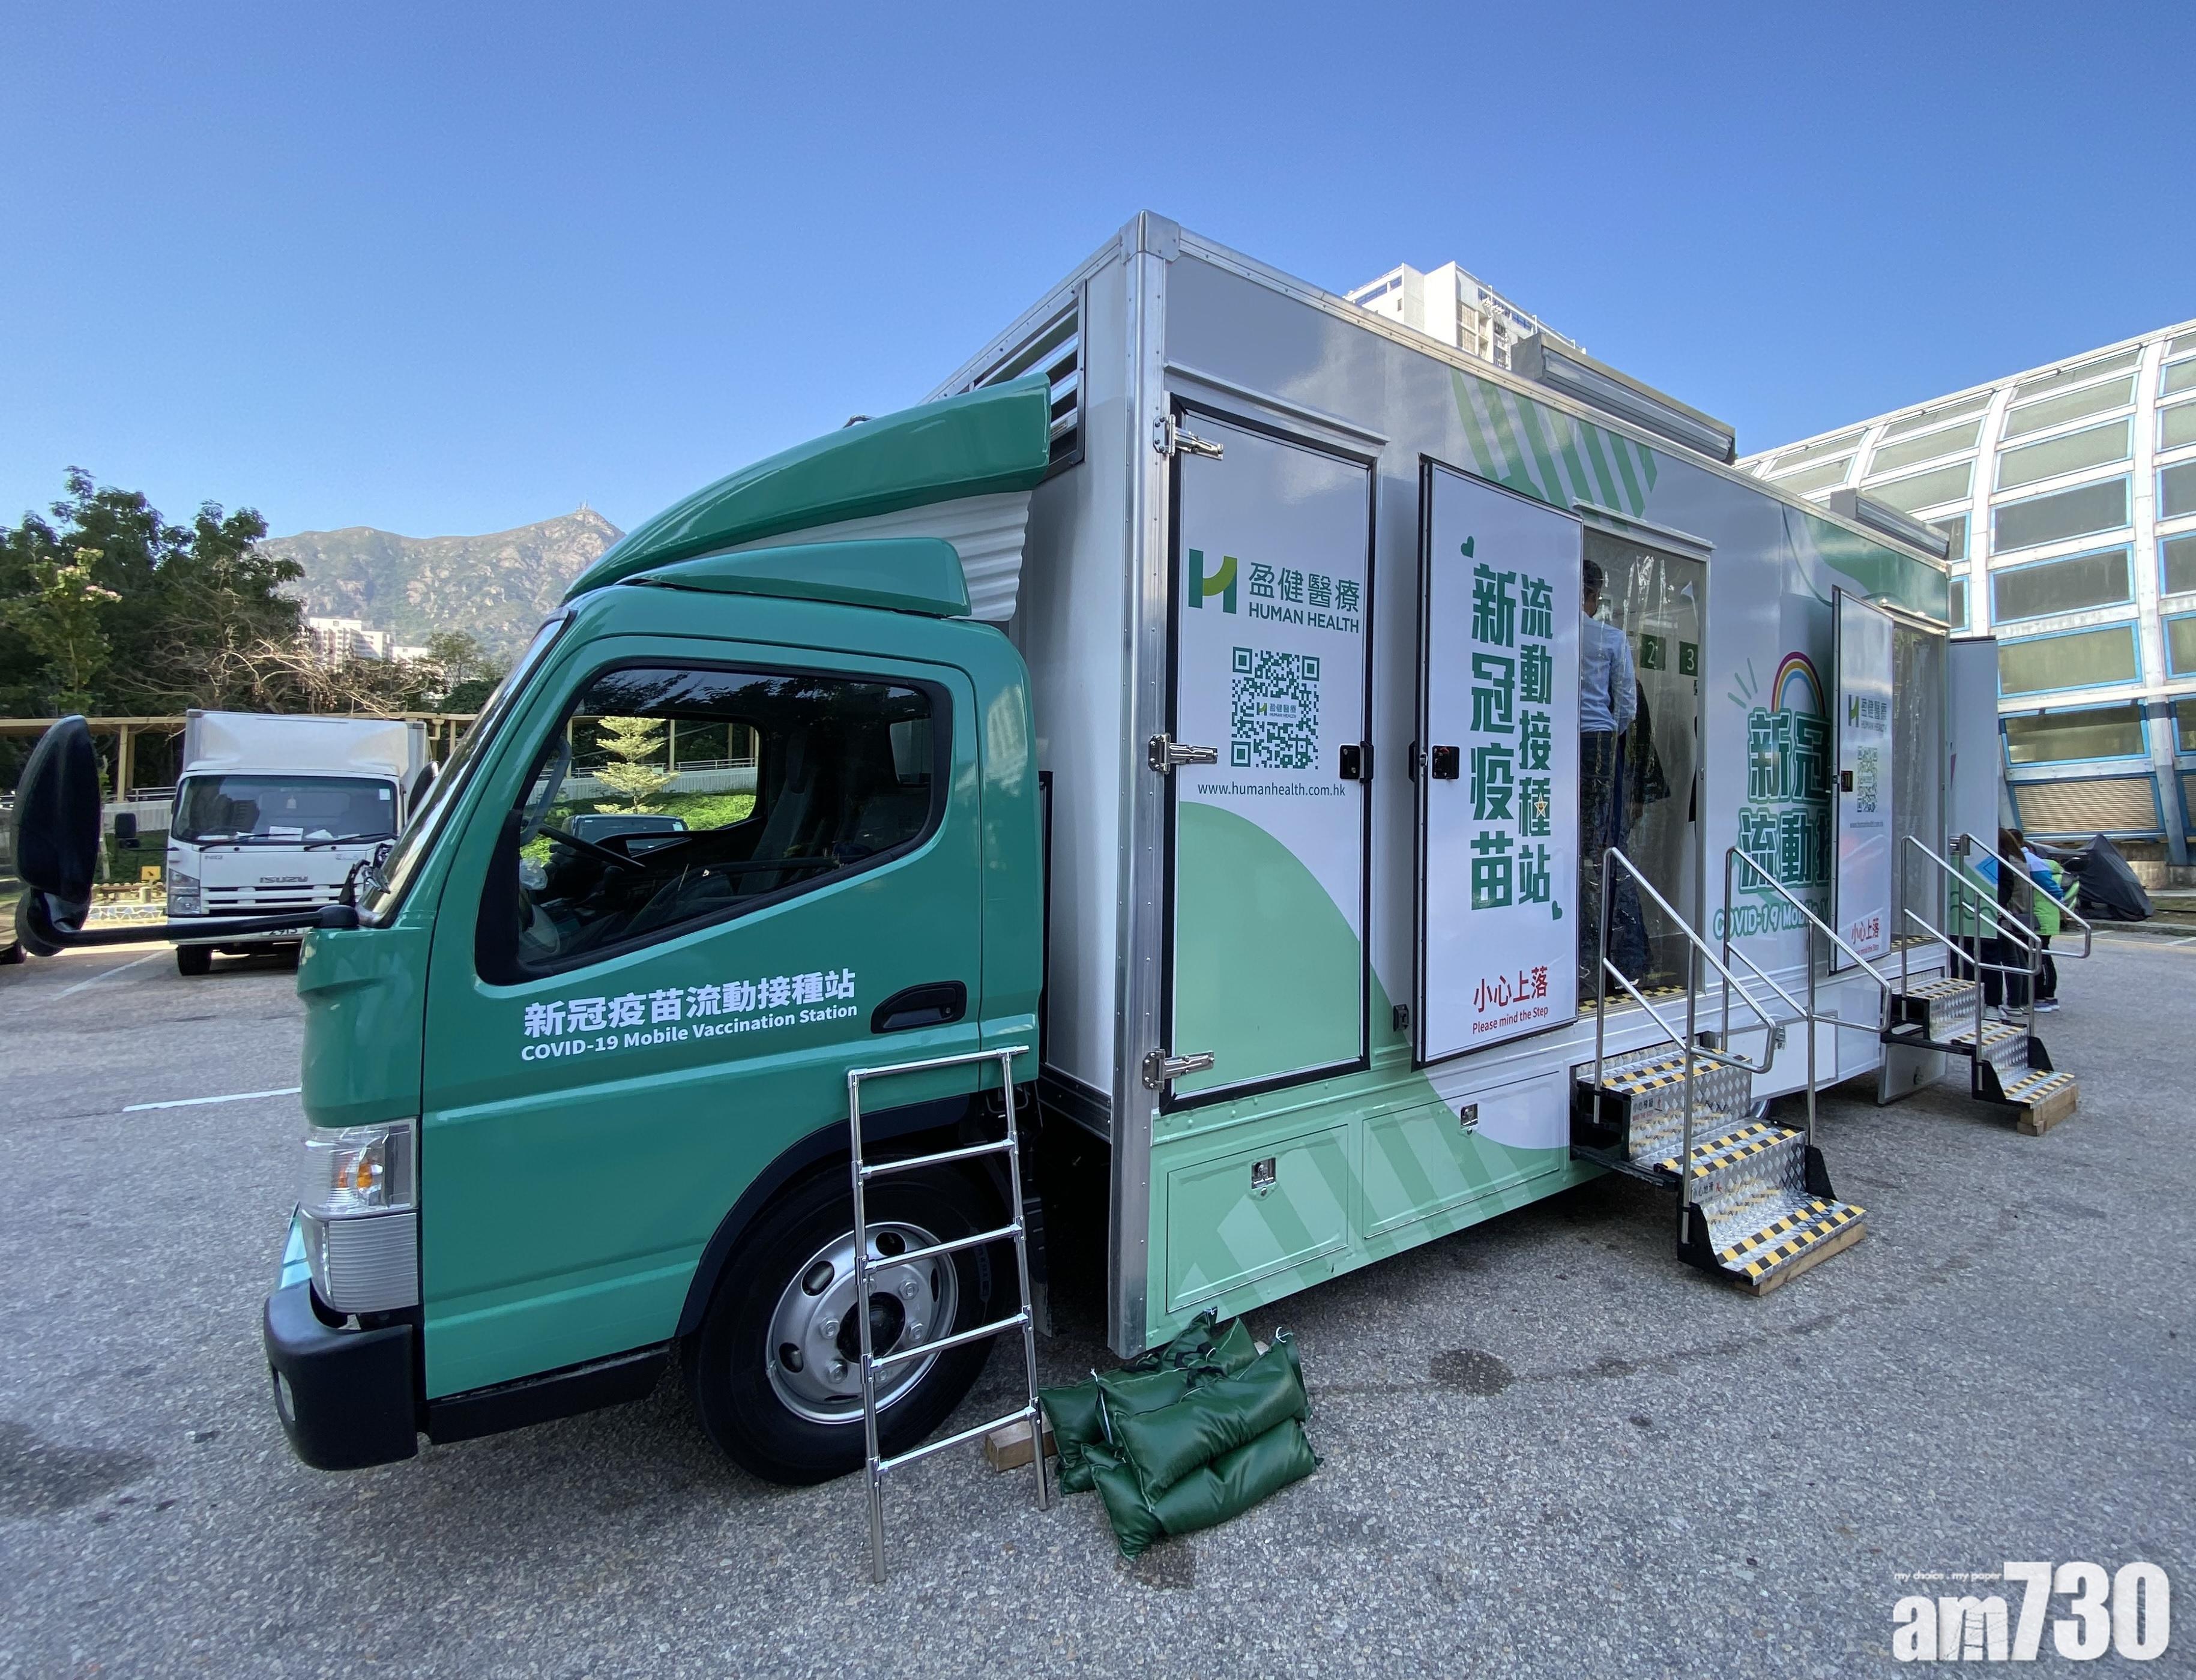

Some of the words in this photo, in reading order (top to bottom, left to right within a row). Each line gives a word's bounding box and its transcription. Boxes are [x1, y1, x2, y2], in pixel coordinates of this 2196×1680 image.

[1248, 562, 1360, 613] 盈健醫療
[1249, 602, 1303, 625] HUMAN
[1308, 612, 1359, 634] HEALTH
[1648, 640, 1655, 664] 2
[1687, 648, 1695, 671] 3
[1470, 563, 1516, 911] 新冠疫苗
[1518, 573, 1554, 905] 流動接種站
[1198, 781, 1345, 796] www.humanhealth.com.hk
[1851, 917, 1879, 945] 小心上落
[523, 968, 855, 1038] 新冠疫苗流動接種站
[1473, 965, 1548, 1013] 小心上落
[521, 1035, 618, 1061] COVID-19
[624, 1026, 688, 1048] Mobile
[692, 1013, 795, 1038] Vaccination
[799, 1004, 857, 1023] Station
[1473, 1020, 1497, 1034] Please
[1500, 1011, 1518, 1027] mind
[1519, 1010, 1531, 1021] the
[1533, 1007, 1548, 1018] Step
